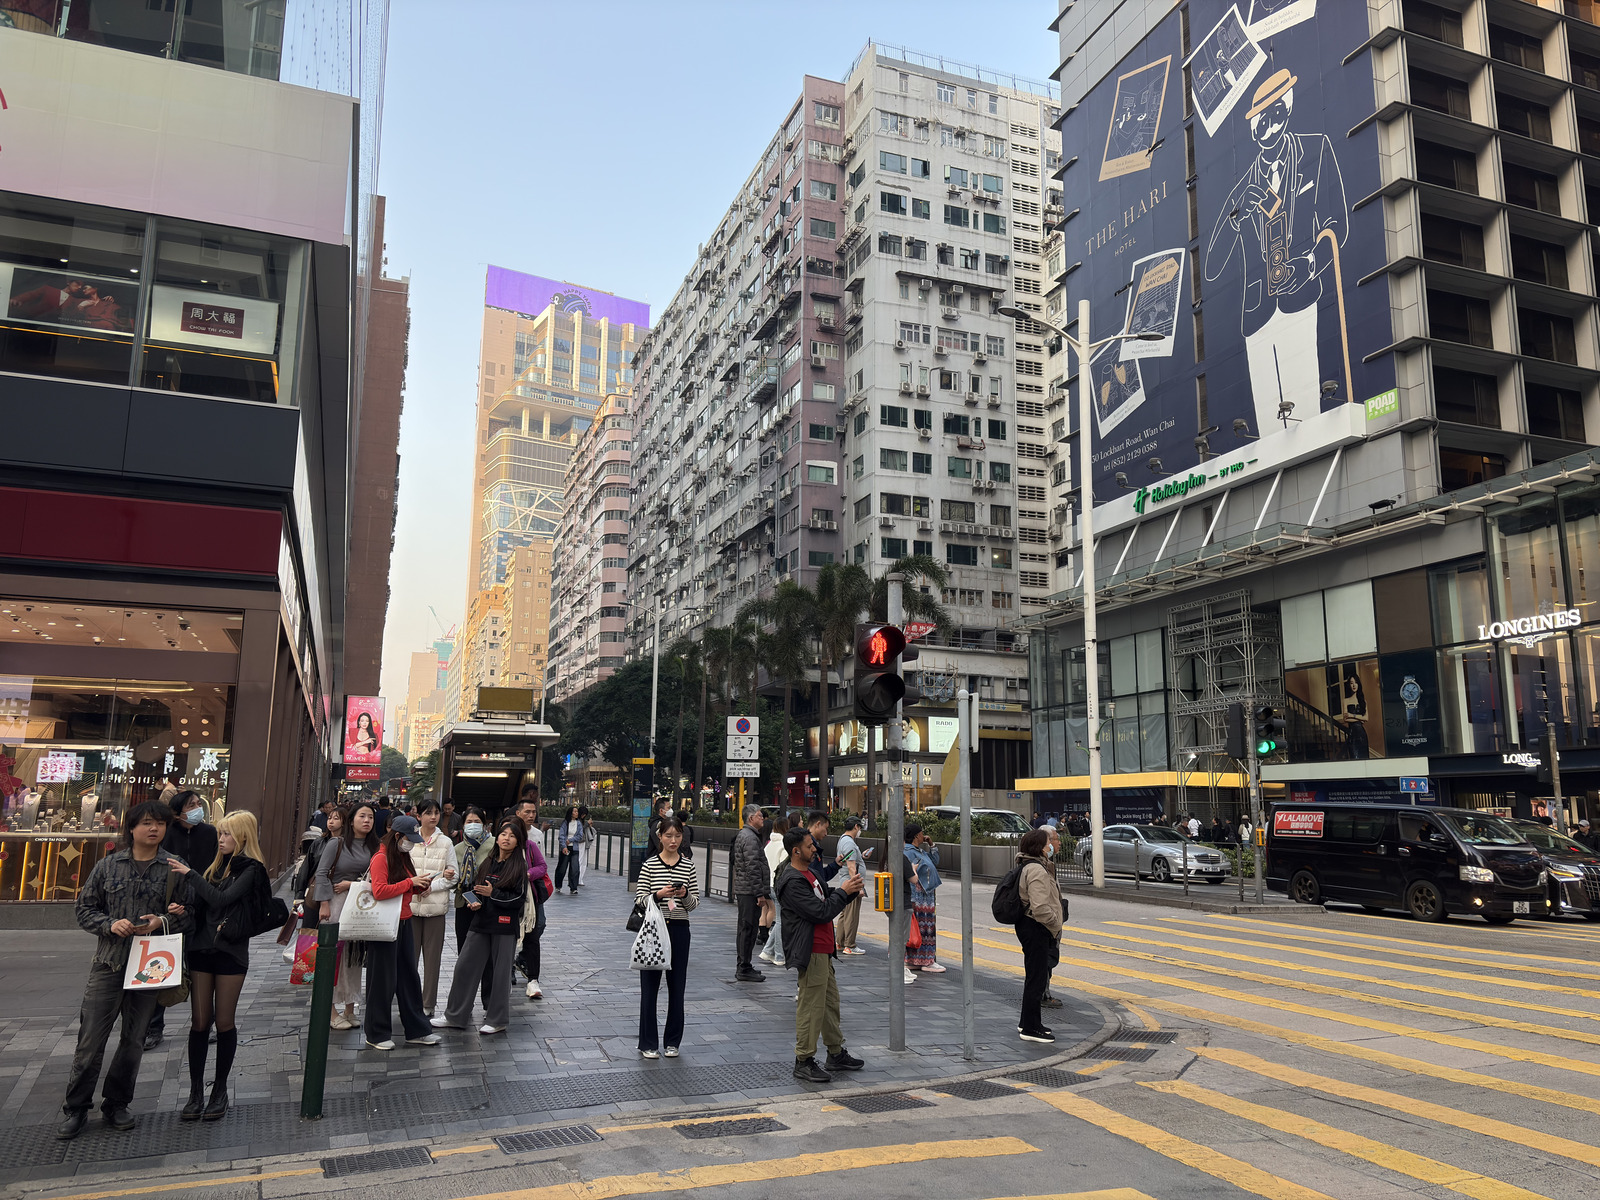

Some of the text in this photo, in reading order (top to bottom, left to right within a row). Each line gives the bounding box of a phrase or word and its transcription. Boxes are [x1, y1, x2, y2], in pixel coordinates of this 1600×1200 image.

[1085, 180, 1167, 255] THE HARI
[1114, 237, 1137, 257] HOTEL
[582, 295, 593, 310] YARN
[190, 307, 236, 325] 周大福
[1368, 391, 1396, 413] POAD
[1100, 441, 1125, 460] Lockhart
[1125, 433, 1143, 448] Road,
[1143, 426, 1158, 439] Wan
[1159, 416, 1175, 432] Chai
[1103, 462, 1111, 471] tel
[1151, 479, 1188, 503] Holiday
[1188, 473, 1207, 489] Inn
[1219, 468, 1228, 477] BY
[1230, 461, 1244, 473] IHG
[1477, 608, 1582, 641] LONGINES
[748, 737, 753, 745] 7
[1401, 737, 1428, 745] LONGINES
[1502, 750, 1560, 764] LONGS
[901, 767, 932, 776] RAO
[1282, 814, 1323, 823] LALAMOVE
